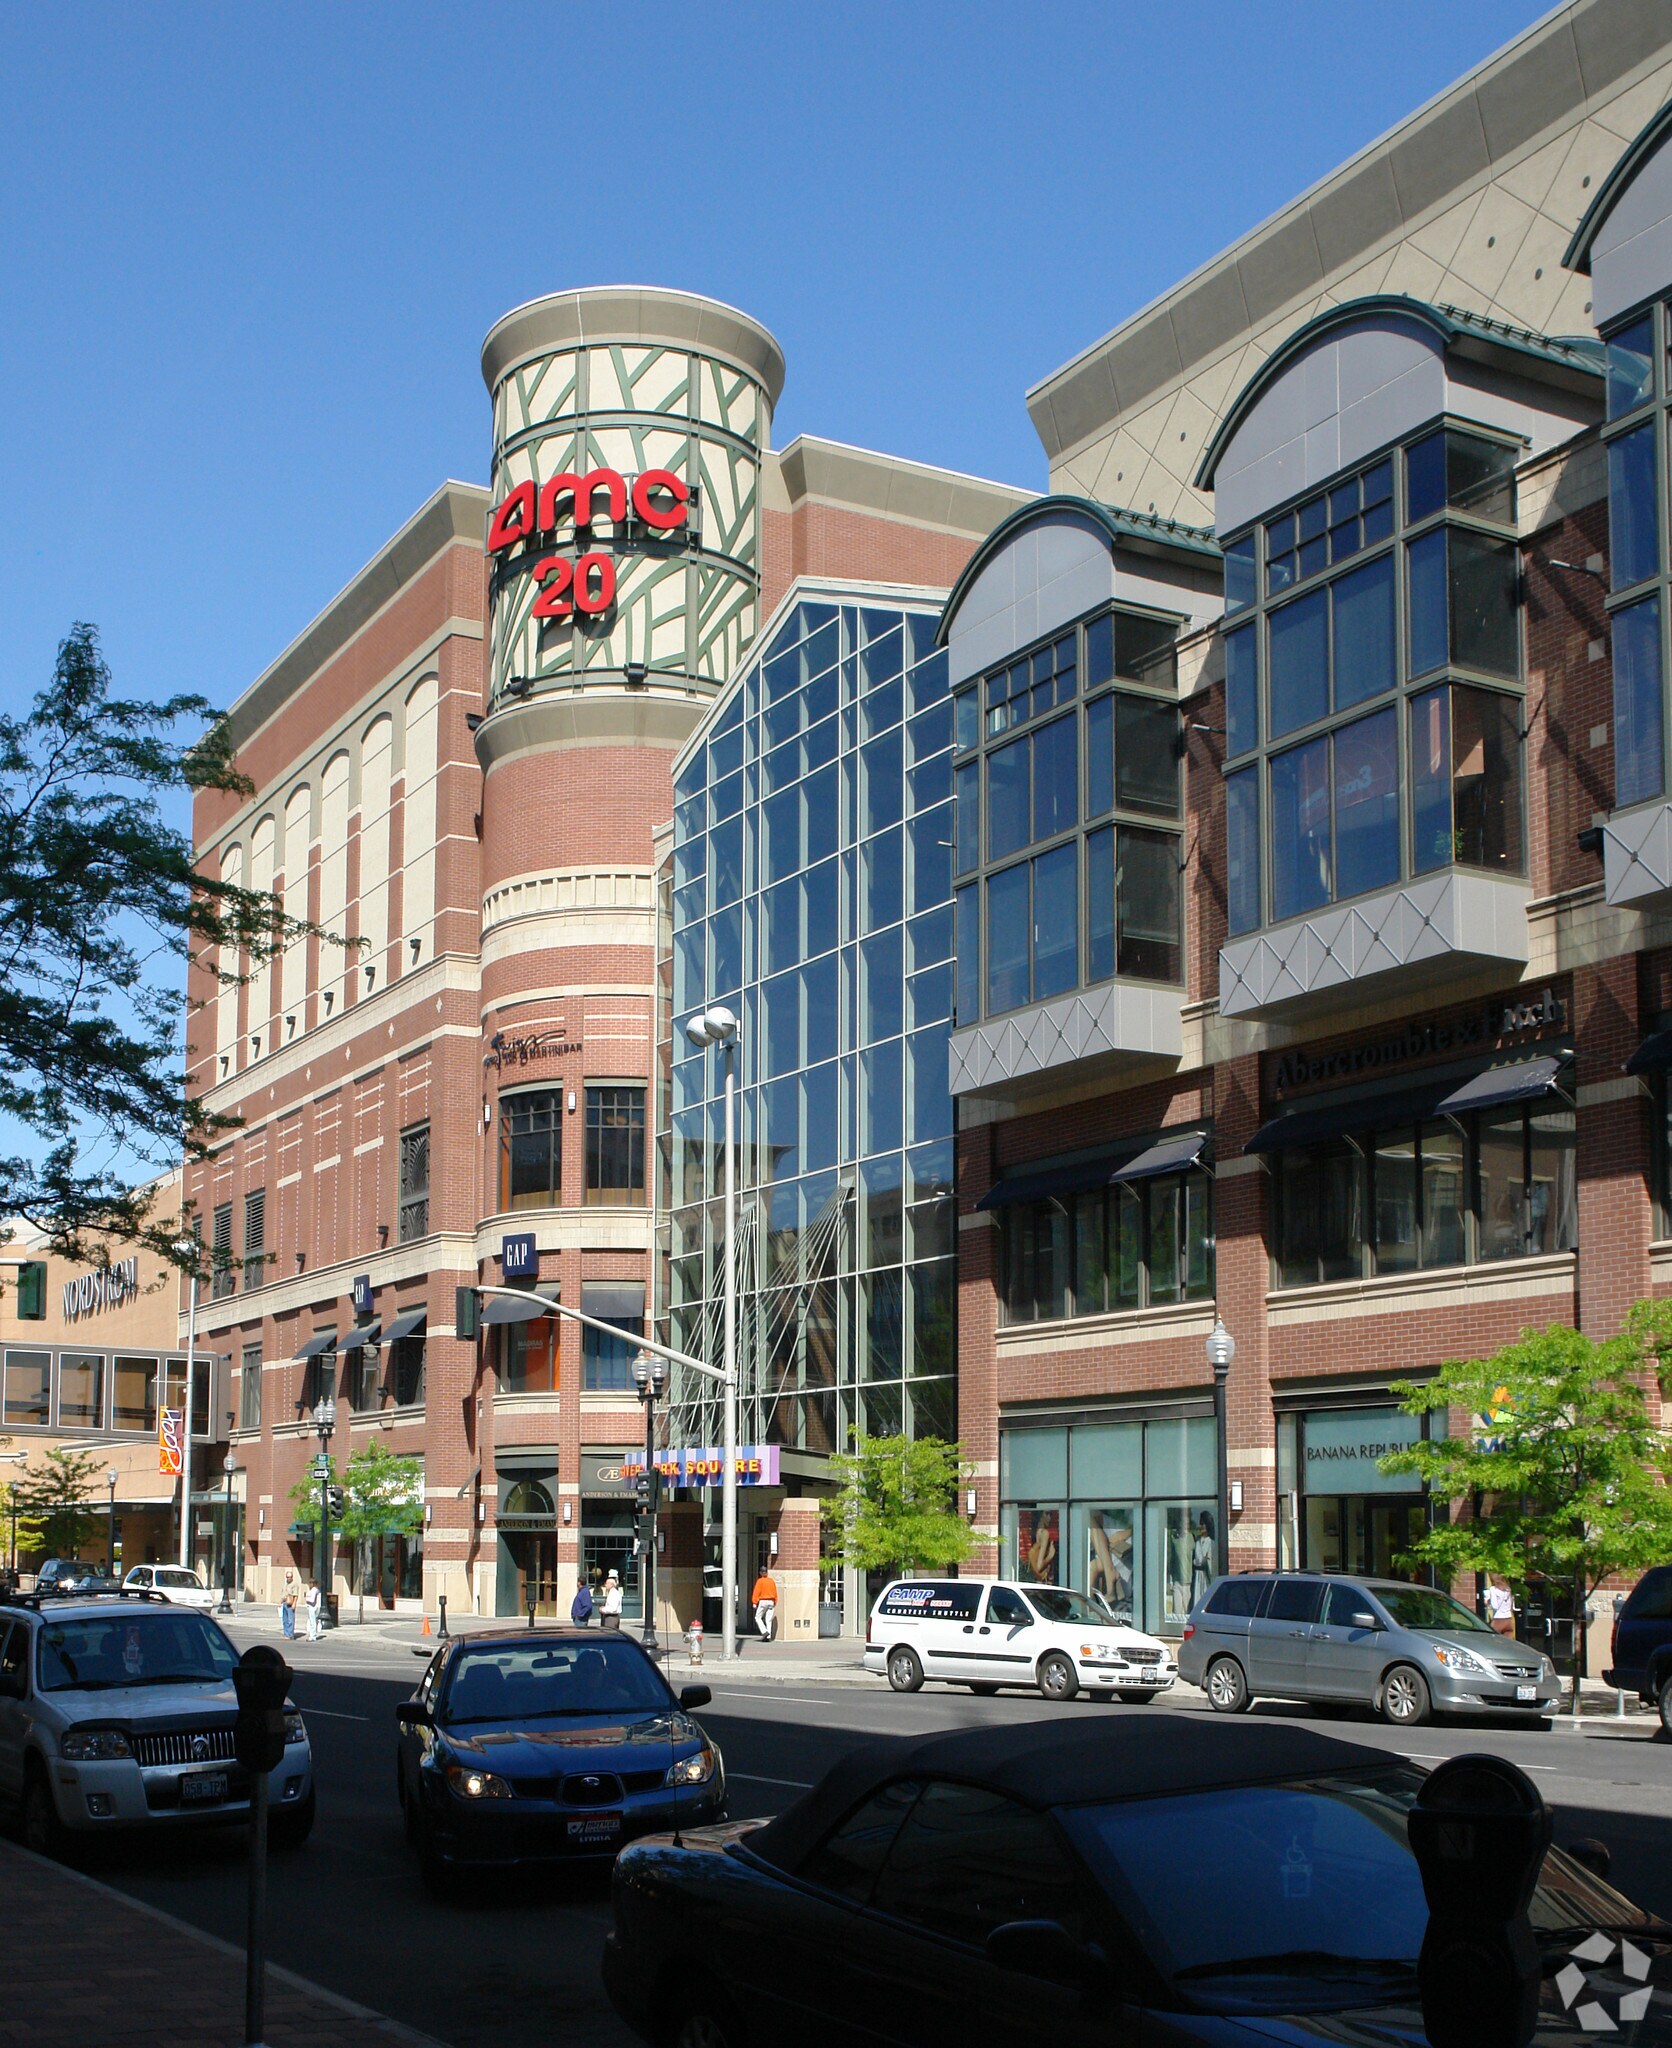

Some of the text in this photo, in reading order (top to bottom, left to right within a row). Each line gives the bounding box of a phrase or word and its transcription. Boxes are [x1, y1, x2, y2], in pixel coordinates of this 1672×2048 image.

[532, 552, 616, 618] 20
[1277, 988, 1559, 1087] Abercrombie & Fitch
[506, 1243, 528, 1266] GAP
[1307, 1446, 1357, 1460] BANANA
[686, 1459, 762, 1475] SQURE
[888, 1588, 935, 1600] CAMP
[887, 1608, 928, 1616] COURTESY
